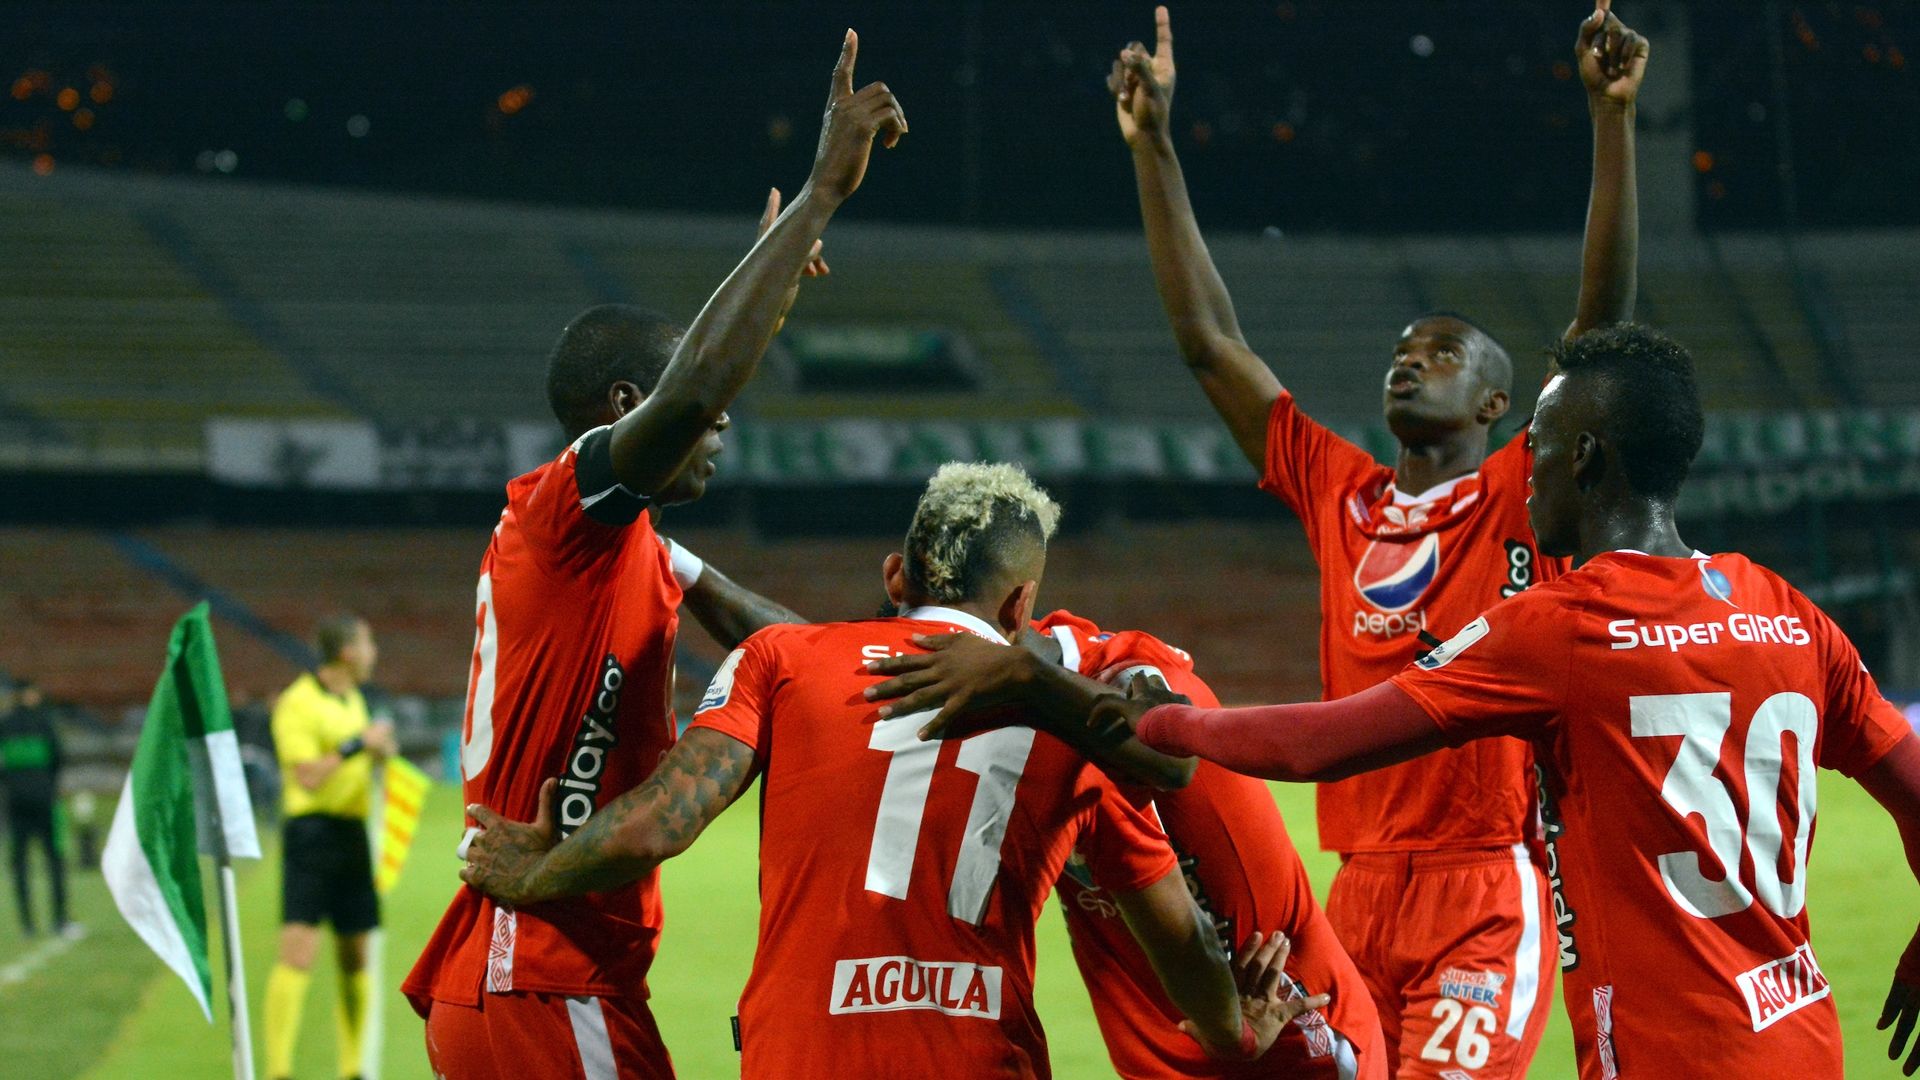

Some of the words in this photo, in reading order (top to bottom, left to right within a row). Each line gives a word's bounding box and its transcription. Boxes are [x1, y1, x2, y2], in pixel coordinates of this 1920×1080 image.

[1353, 608, 1428, 639] pepsi
[1608, 618, 1724, 653] Super
[1727, 613, 1811, 646] GIROS
[864, 707, 1037, 927] 11
[1629, 691, 1818, 919] 30
[840, 960, 990, 1014] AGUILA
[1441, 982, 1498, 1007] INTER
[1421, 998, 1497, 1070] 26
